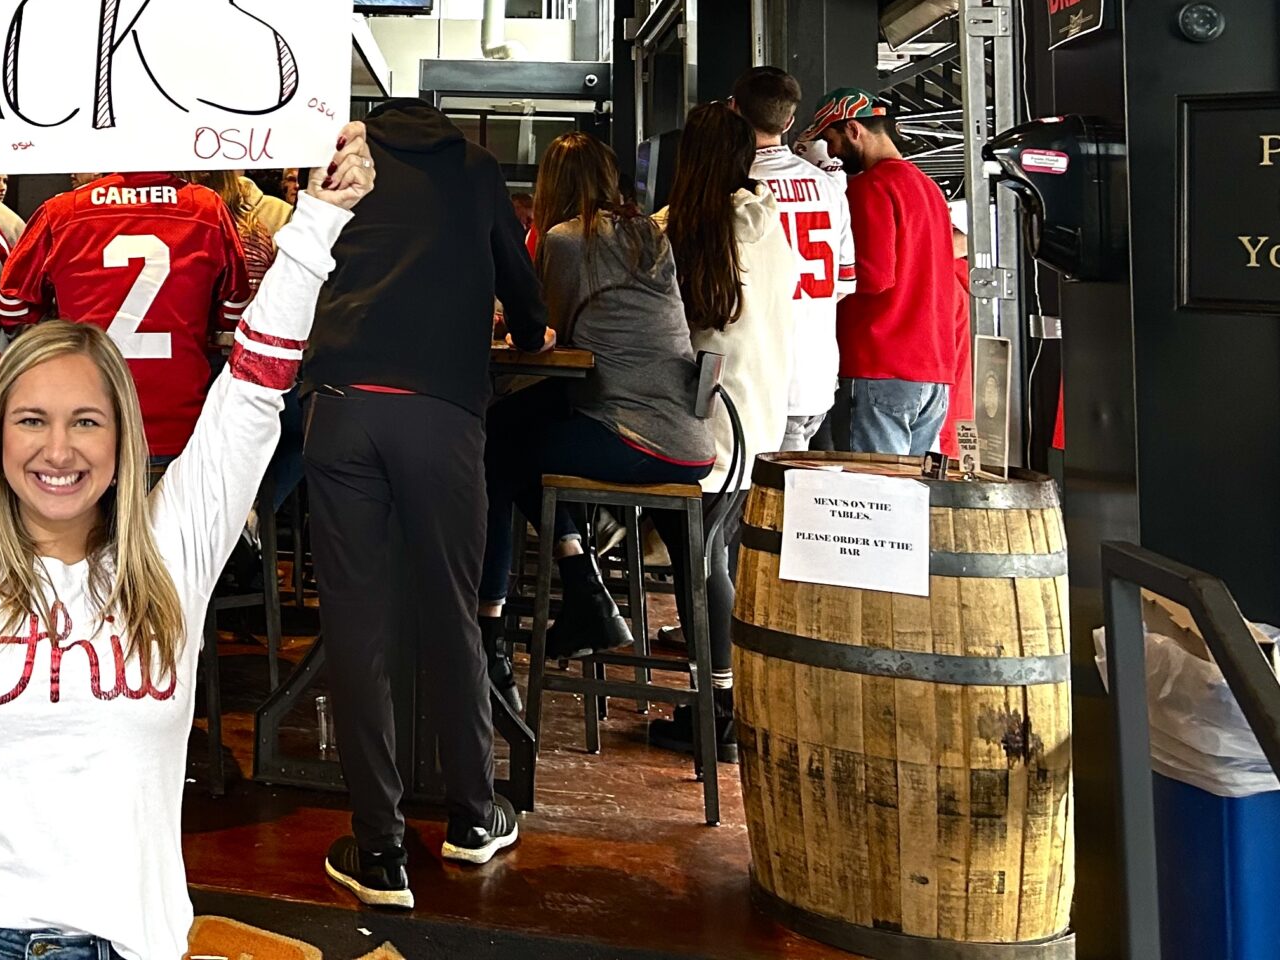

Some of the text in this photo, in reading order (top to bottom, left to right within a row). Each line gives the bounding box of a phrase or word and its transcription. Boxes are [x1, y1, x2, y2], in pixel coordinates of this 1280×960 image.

[308, 98, 335, 119] OSU
[194, 127, 275, 162] OSU
[90, 185, 178, 206] CARTER
[767, 178, 820, 202] ELLIOTT
[101, 233, 172, 359] 2
[814, 497, 892, 512] MENU'S ON THE
[829, 509, 872, 521] TABLES.
[796, 531, 913, 551] PLEASE ORDER AT THE
[839, 547, 861, 556] BAR
